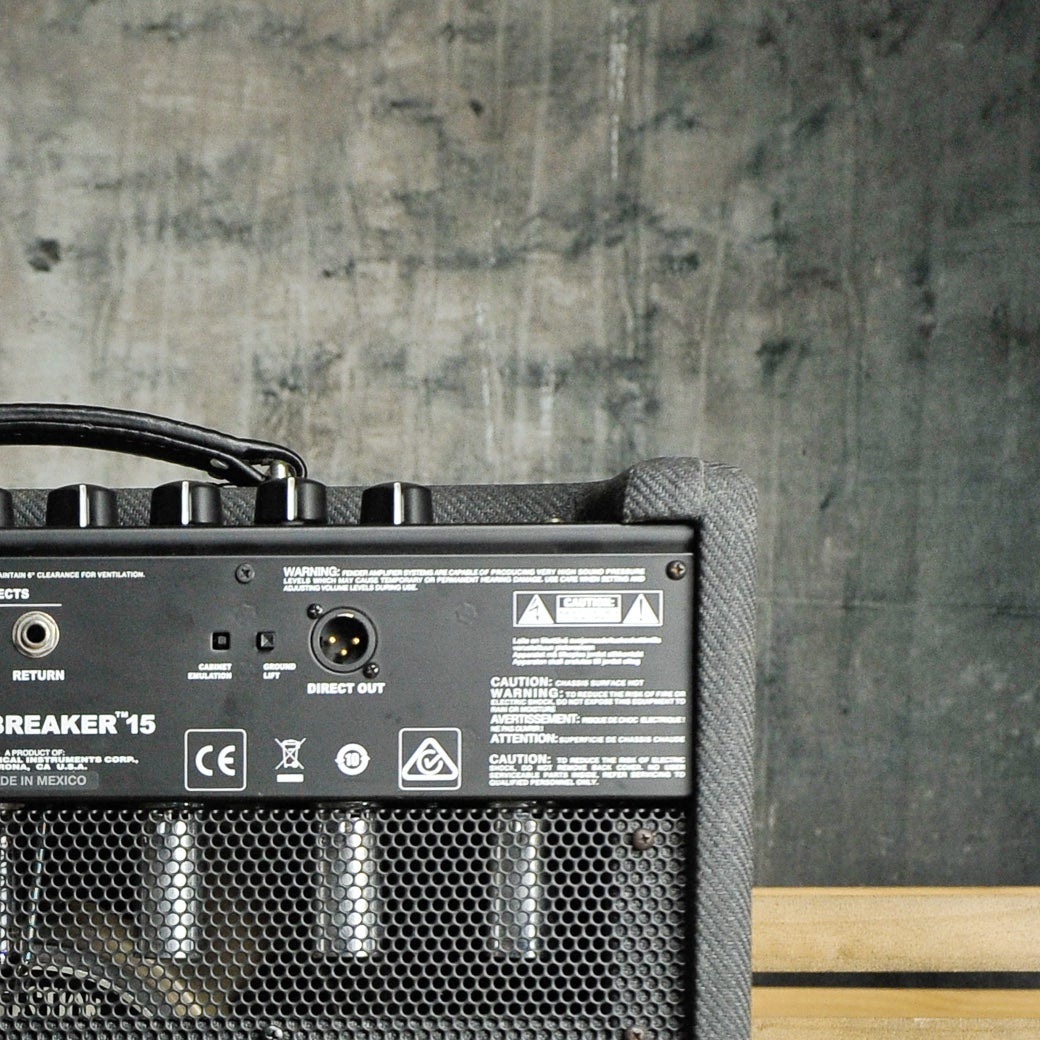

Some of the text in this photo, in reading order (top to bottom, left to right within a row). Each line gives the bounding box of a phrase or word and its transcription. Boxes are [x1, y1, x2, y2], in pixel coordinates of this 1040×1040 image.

[12, 670, 65, 680] RETURN
[490, 677, 552, 687] CAUTION:
[307, 683, 385, 694] DIRECT OUT
[490, 688, 563, 698] WARNING:
[126, 714, 156, 734] 15
[490, 714, 580, 724] AVERTISSEMENT:
[490, 733, 558, 743] ATTENTION:
[195, 745, 236, 776] CE
[489, 754, 551, 764] CAUTION:
[21, 776, 34, 785] IN
[37, 776, 87, 785] MEXICO
